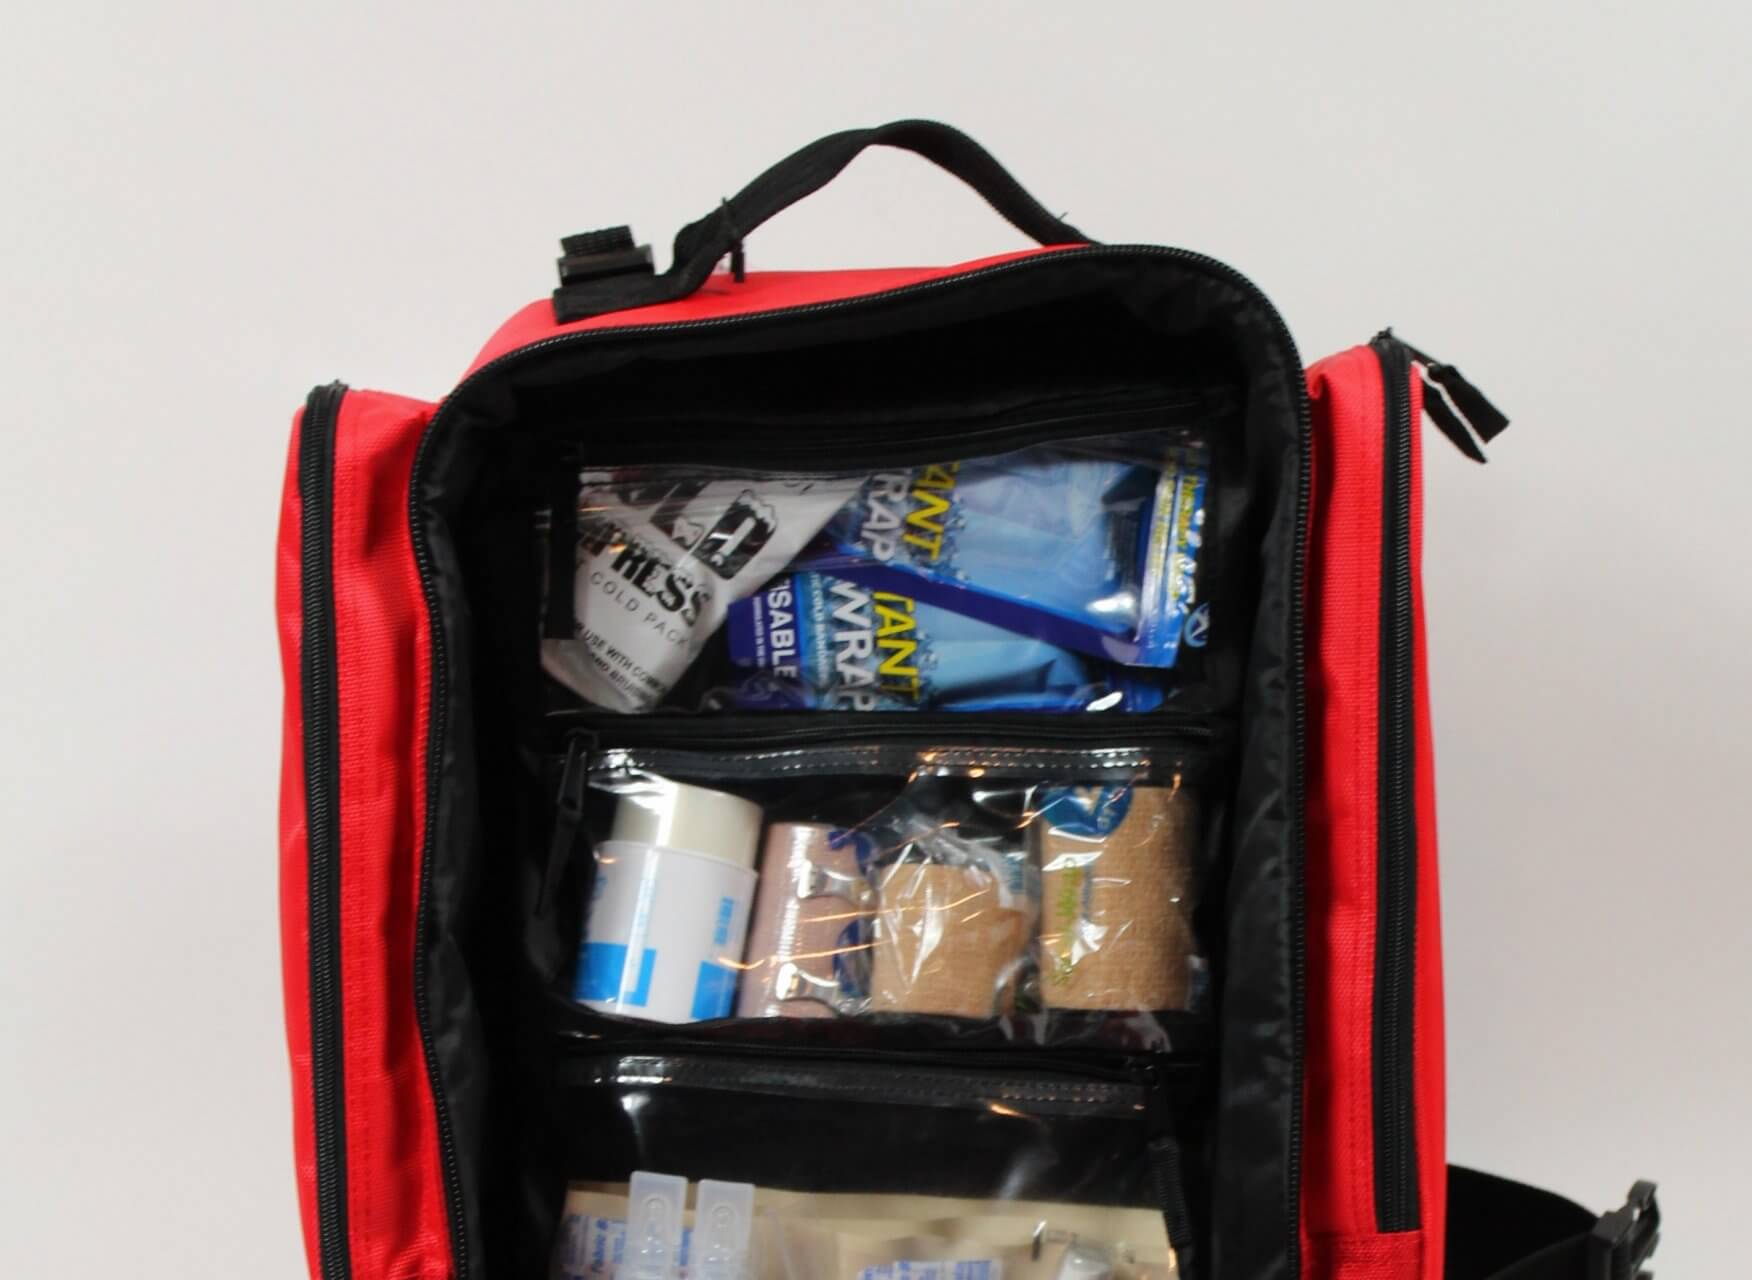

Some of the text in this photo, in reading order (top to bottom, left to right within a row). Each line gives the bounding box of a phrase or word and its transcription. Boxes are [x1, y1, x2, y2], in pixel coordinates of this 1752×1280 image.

[861, 469, 912, 561] RAP
[591, 571, 640, 612] COLD
[829, 582, 877, 712] WRAP
